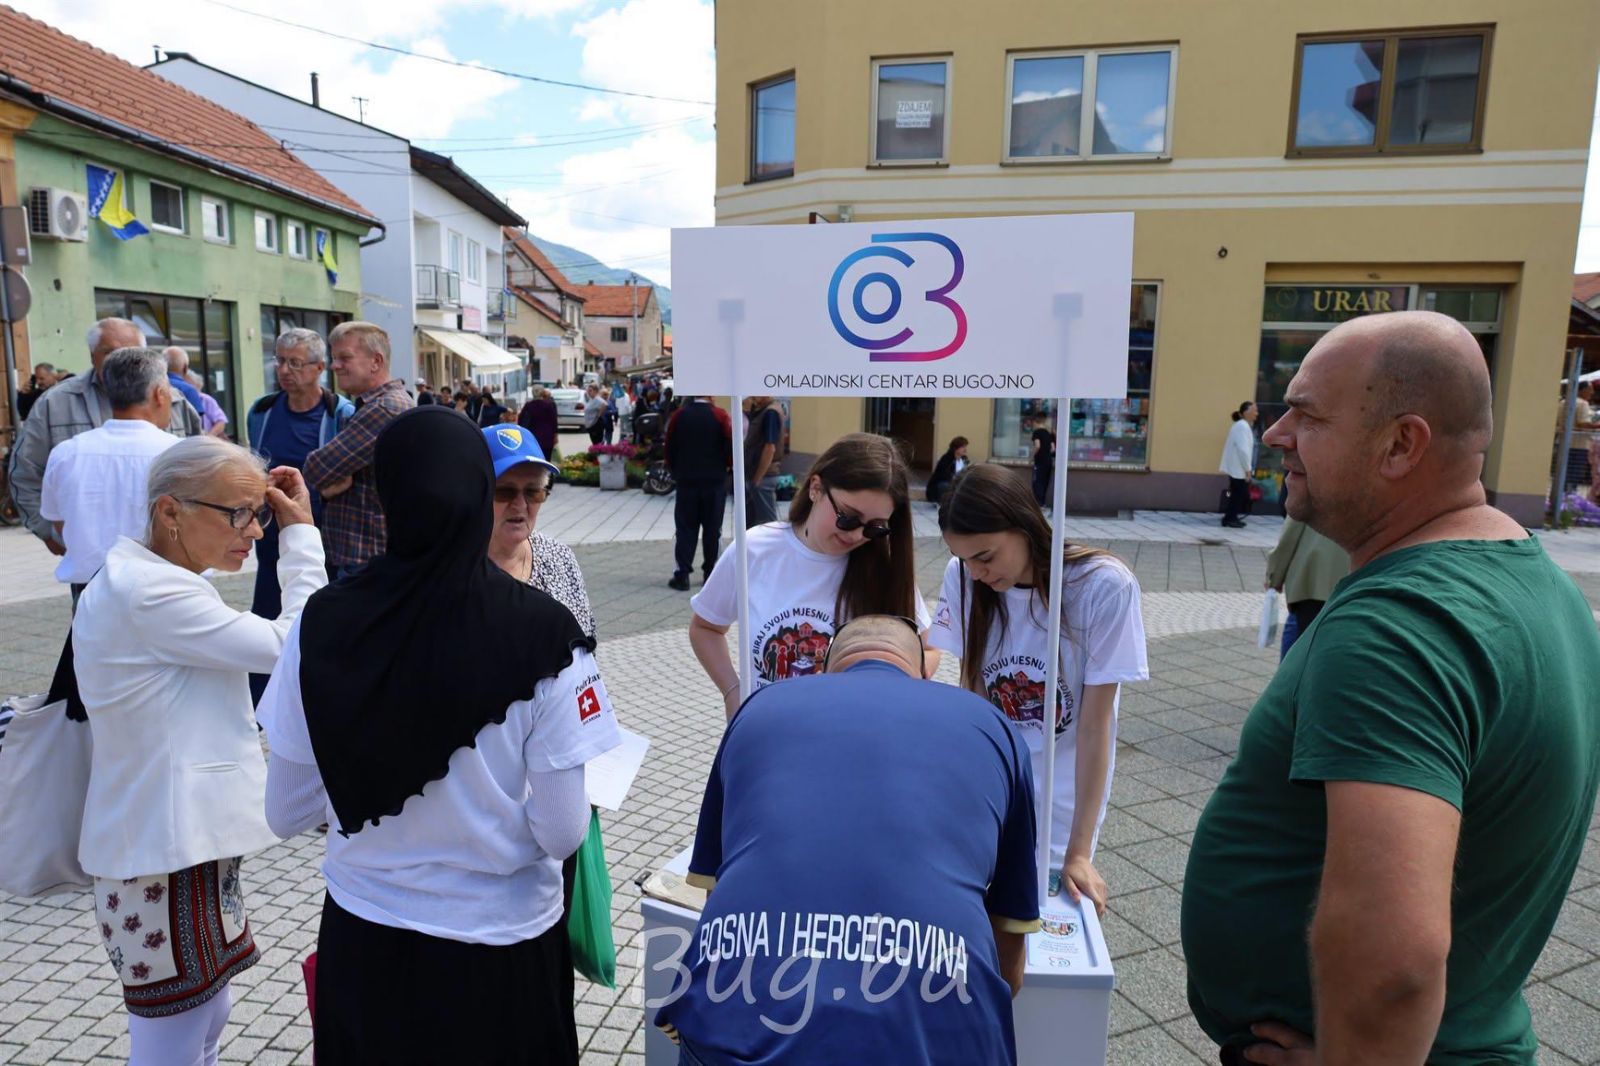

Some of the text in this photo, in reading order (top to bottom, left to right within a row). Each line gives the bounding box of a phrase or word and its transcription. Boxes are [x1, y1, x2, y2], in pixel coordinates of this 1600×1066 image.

[1313, 290, 1392, 312] URAR
[763, 374, 1035, 389] OMLADINSKI CENTAR BUGOJNO
[752, 630, 767, 656] BIRAJ
[763, 609, 791, 632] SVOJU
[792, 607, 831, 623] MJESNU
[982, 657, 1009, 679] SVOJU
[698, 911, 969, 984] BOSNA I HERCEGOVINA
